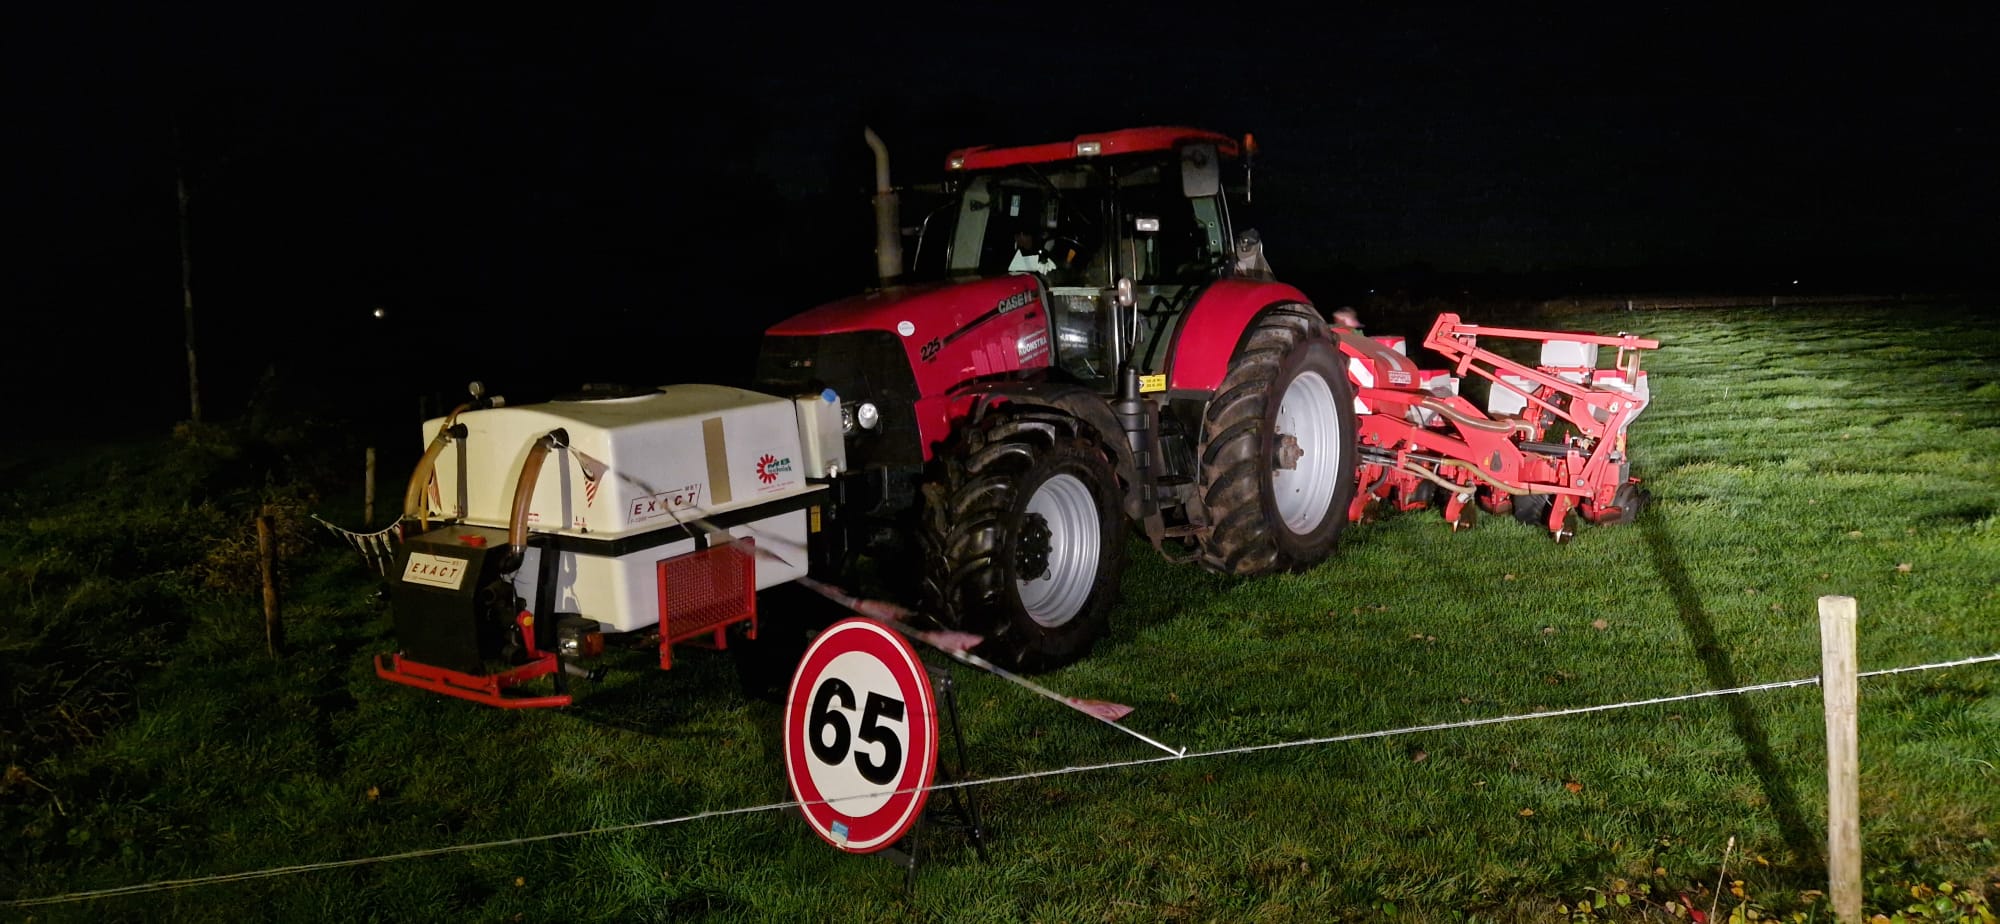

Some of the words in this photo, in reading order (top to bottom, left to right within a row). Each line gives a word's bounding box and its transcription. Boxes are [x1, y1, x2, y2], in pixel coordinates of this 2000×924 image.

[998, 293, 1024, 314] CASE
[921, 336, 940, 362] 225
[634, 492, 695, 516] EXACT
[411, 563, 458, 578] EXACT
[809, 678, 904, 785] 65
